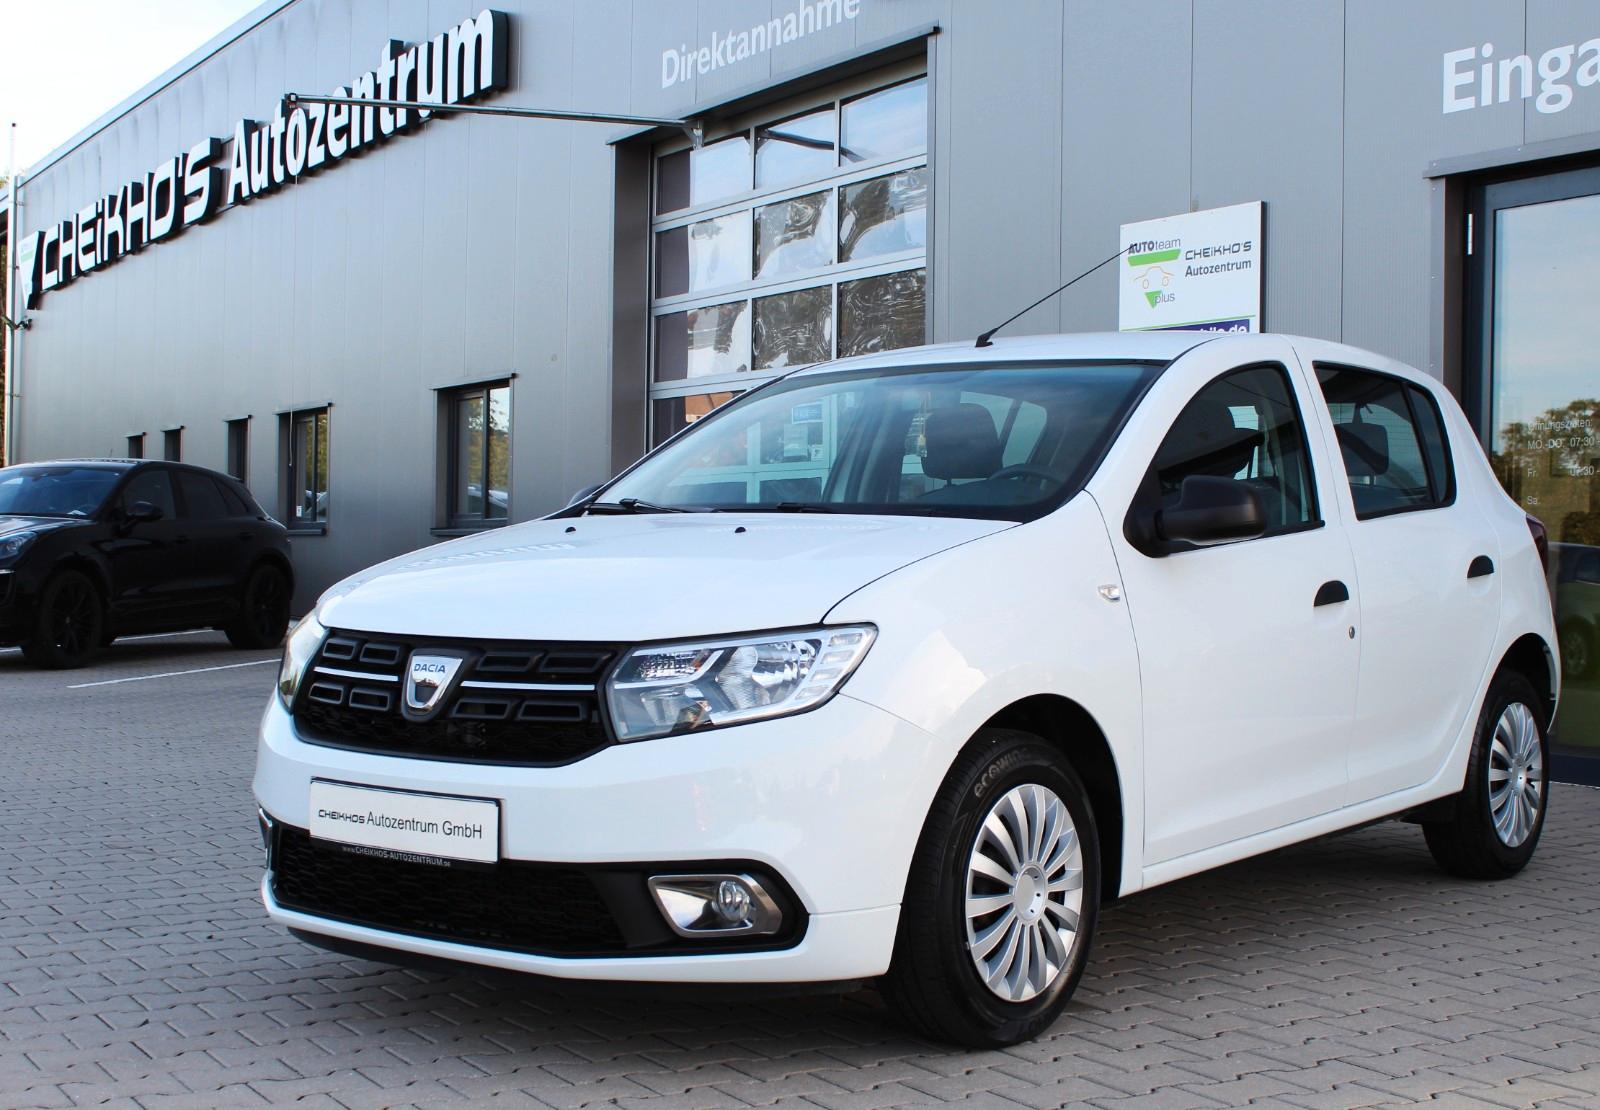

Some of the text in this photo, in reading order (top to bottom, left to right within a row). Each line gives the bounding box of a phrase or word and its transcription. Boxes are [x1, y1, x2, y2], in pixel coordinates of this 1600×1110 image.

[661, 0, 860, 88] Direktannahme
[227, 9, 494, 204] Autozentrum
[1185, 260, 1252, 277] Autozentrum
[1154, 293, 1175, 304] plus
[413, 663, 446, 673] DACIA
[318, 809, 483, 839] CHEIKHOS Autozentrum GmbH
